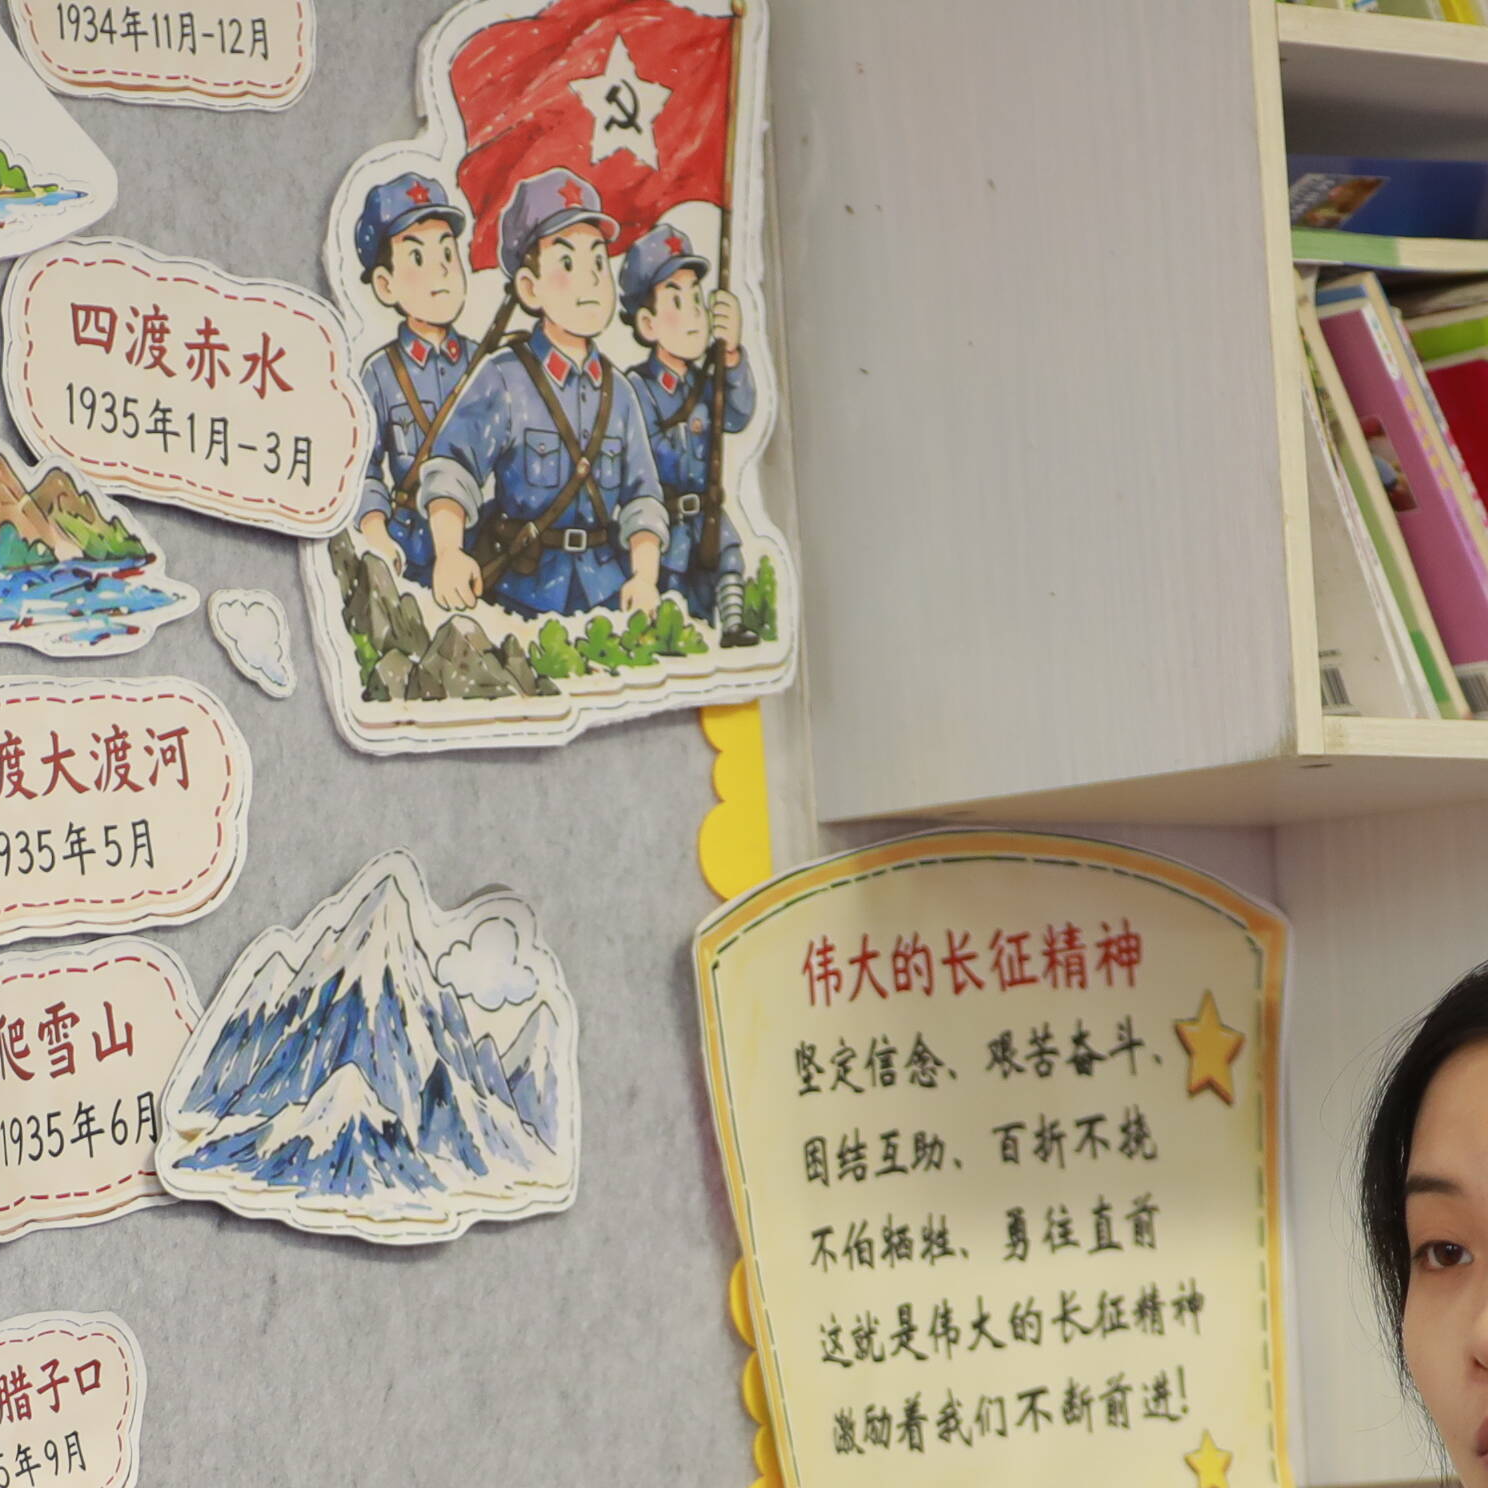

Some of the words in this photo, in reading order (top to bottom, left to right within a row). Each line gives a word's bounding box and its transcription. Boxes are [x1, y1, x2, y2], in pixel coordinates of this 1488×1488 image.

[56, 3, 270, 61] 1934年11月-12月
[70, 301, 295, 400] 四渡赤水
[65, 382, 314, 487] 1935年1月-3月
[800, 916, 1145, 1009] 伟大的长征精神
[0, 1090, 159, 1168] 1935年6月
[818, 1277, 1207, 1369] 这就是伟大的长征精神
